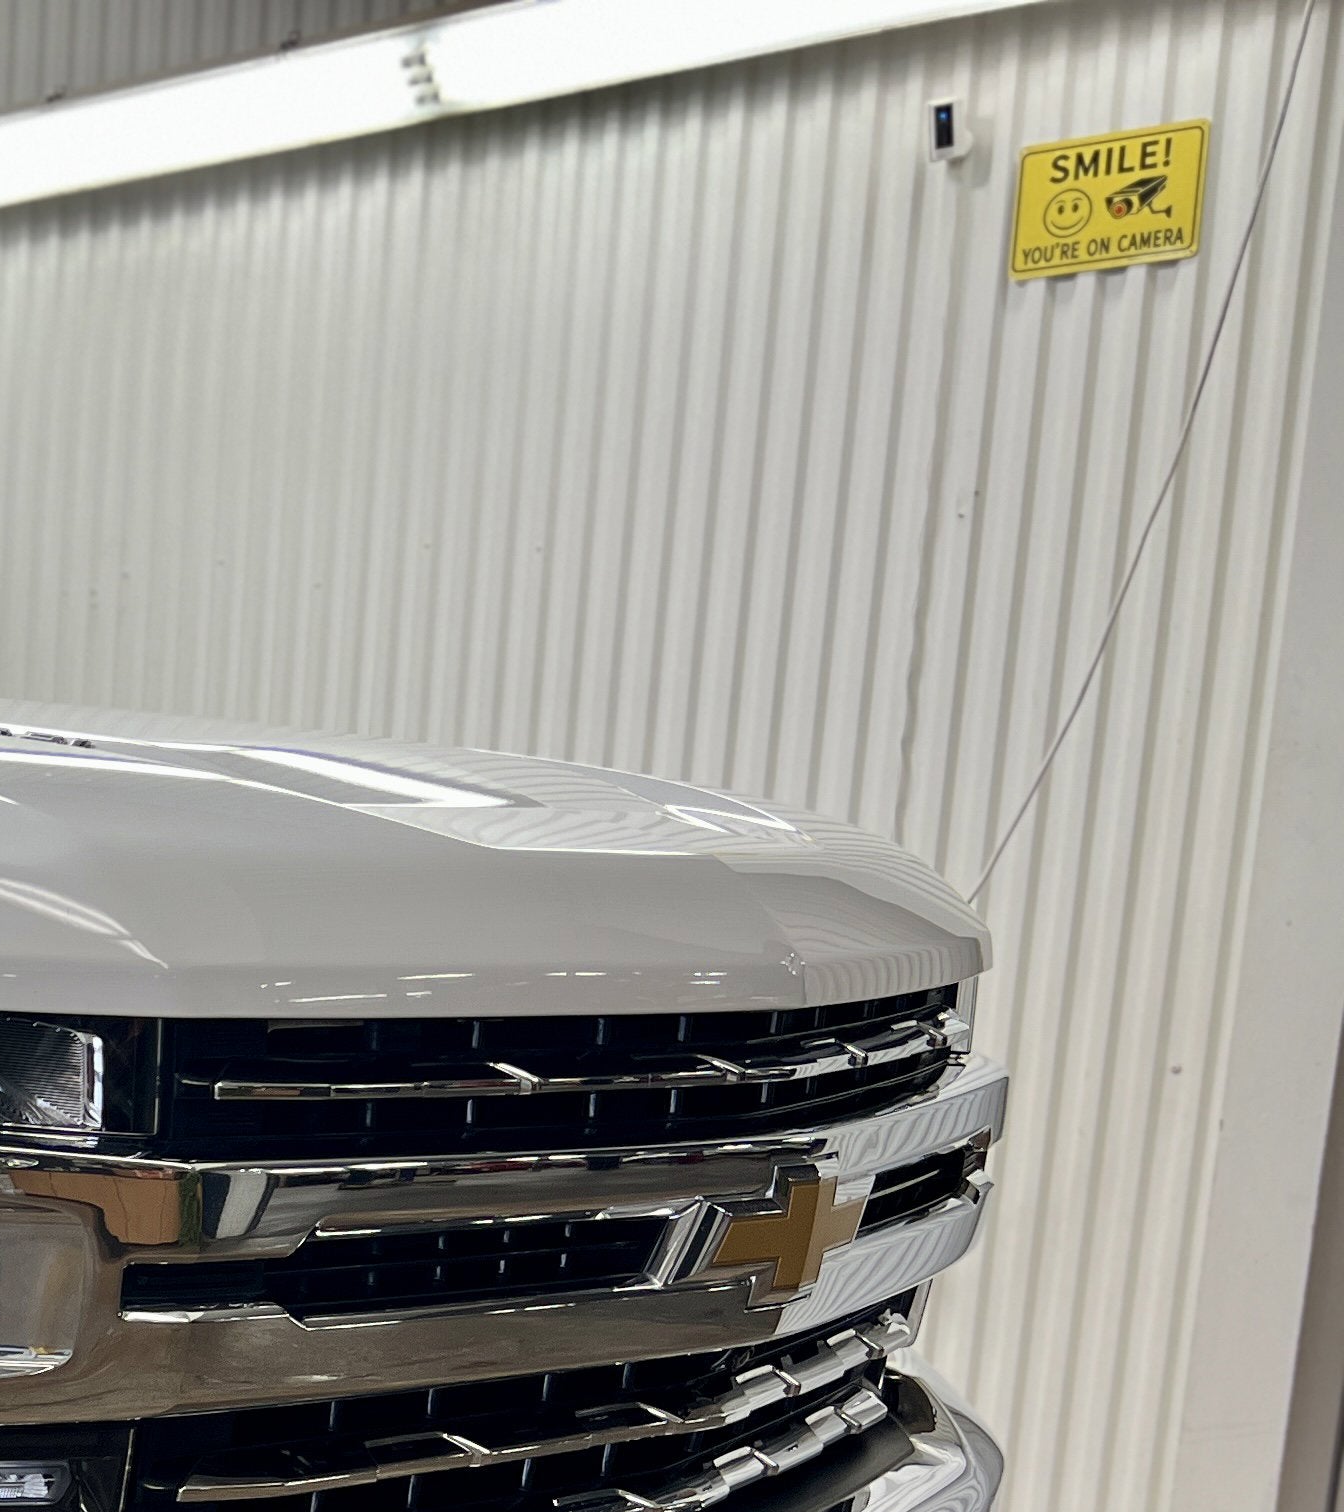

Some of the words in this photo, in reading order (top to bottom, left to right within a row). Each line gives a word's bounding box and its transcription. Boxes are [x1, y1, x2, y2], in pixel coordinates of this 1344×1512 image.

[1049, 137, 1173, 184] SMILE!
[1021, 241, 1081, 266] YOU'RE
[1087, 237, 1111, 257] ON
[1117, 226, 1185, 253] CAMERA
